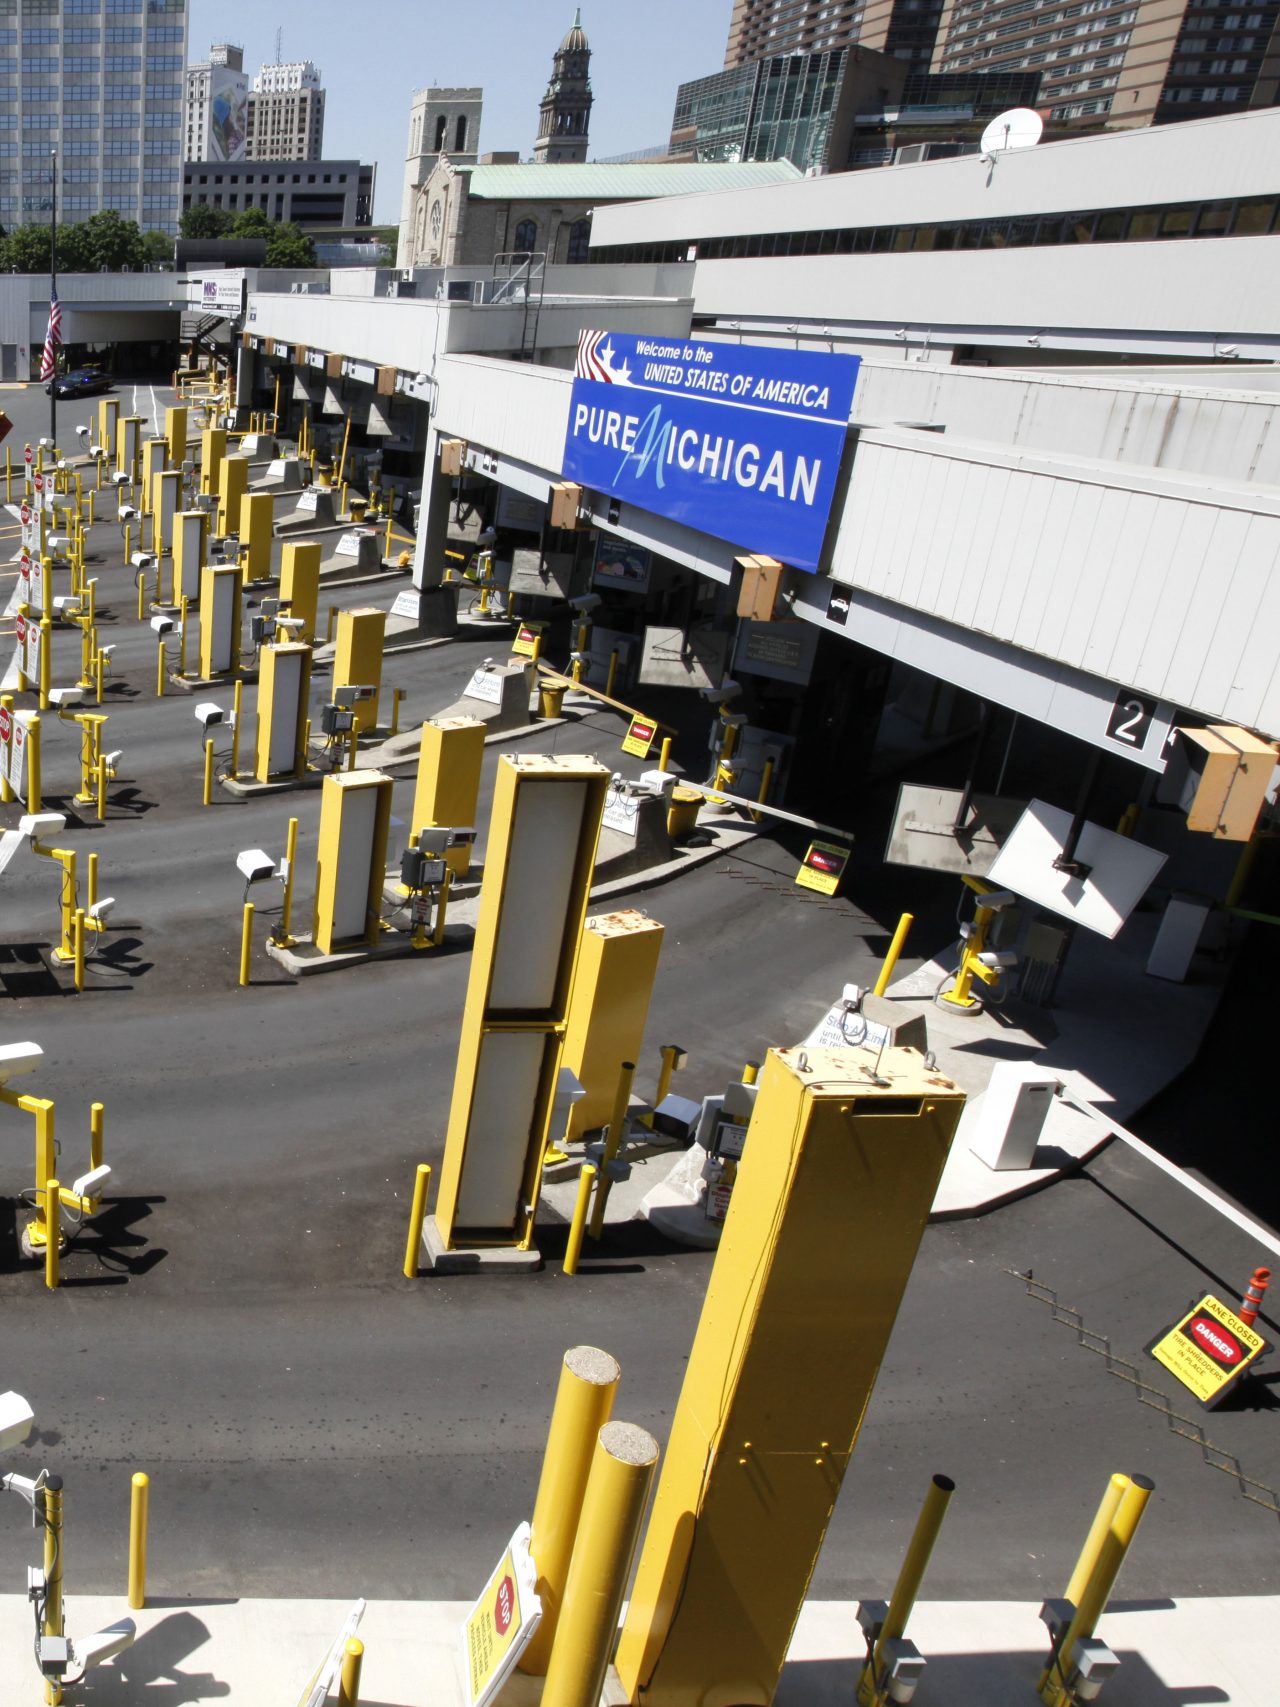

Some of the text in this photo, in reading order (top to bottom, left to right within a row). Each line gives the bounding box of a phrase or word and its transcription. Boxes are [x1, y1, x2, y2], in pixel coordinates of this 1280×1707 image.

[636, 340, 713, 363] Welcome to the
[644, 362, 830, 409] UNITED STATES OF AMERICA
[573, 403, 821, 506] PURE MICHIGAN
[1115, 700, 1144, 741] 2
[822, 1030, 841, 1041] until
[1195, 1322, 1234, 1357] DANGER
[1205, 1299, 1259, 1347] LANE CLOSED
[1172, 1334, 1223, 1381] TIRE SHREDDERS
[1177, 1349, 1206, 1376] IN PLACE
[499, 1583, 510, 1625] STOP
